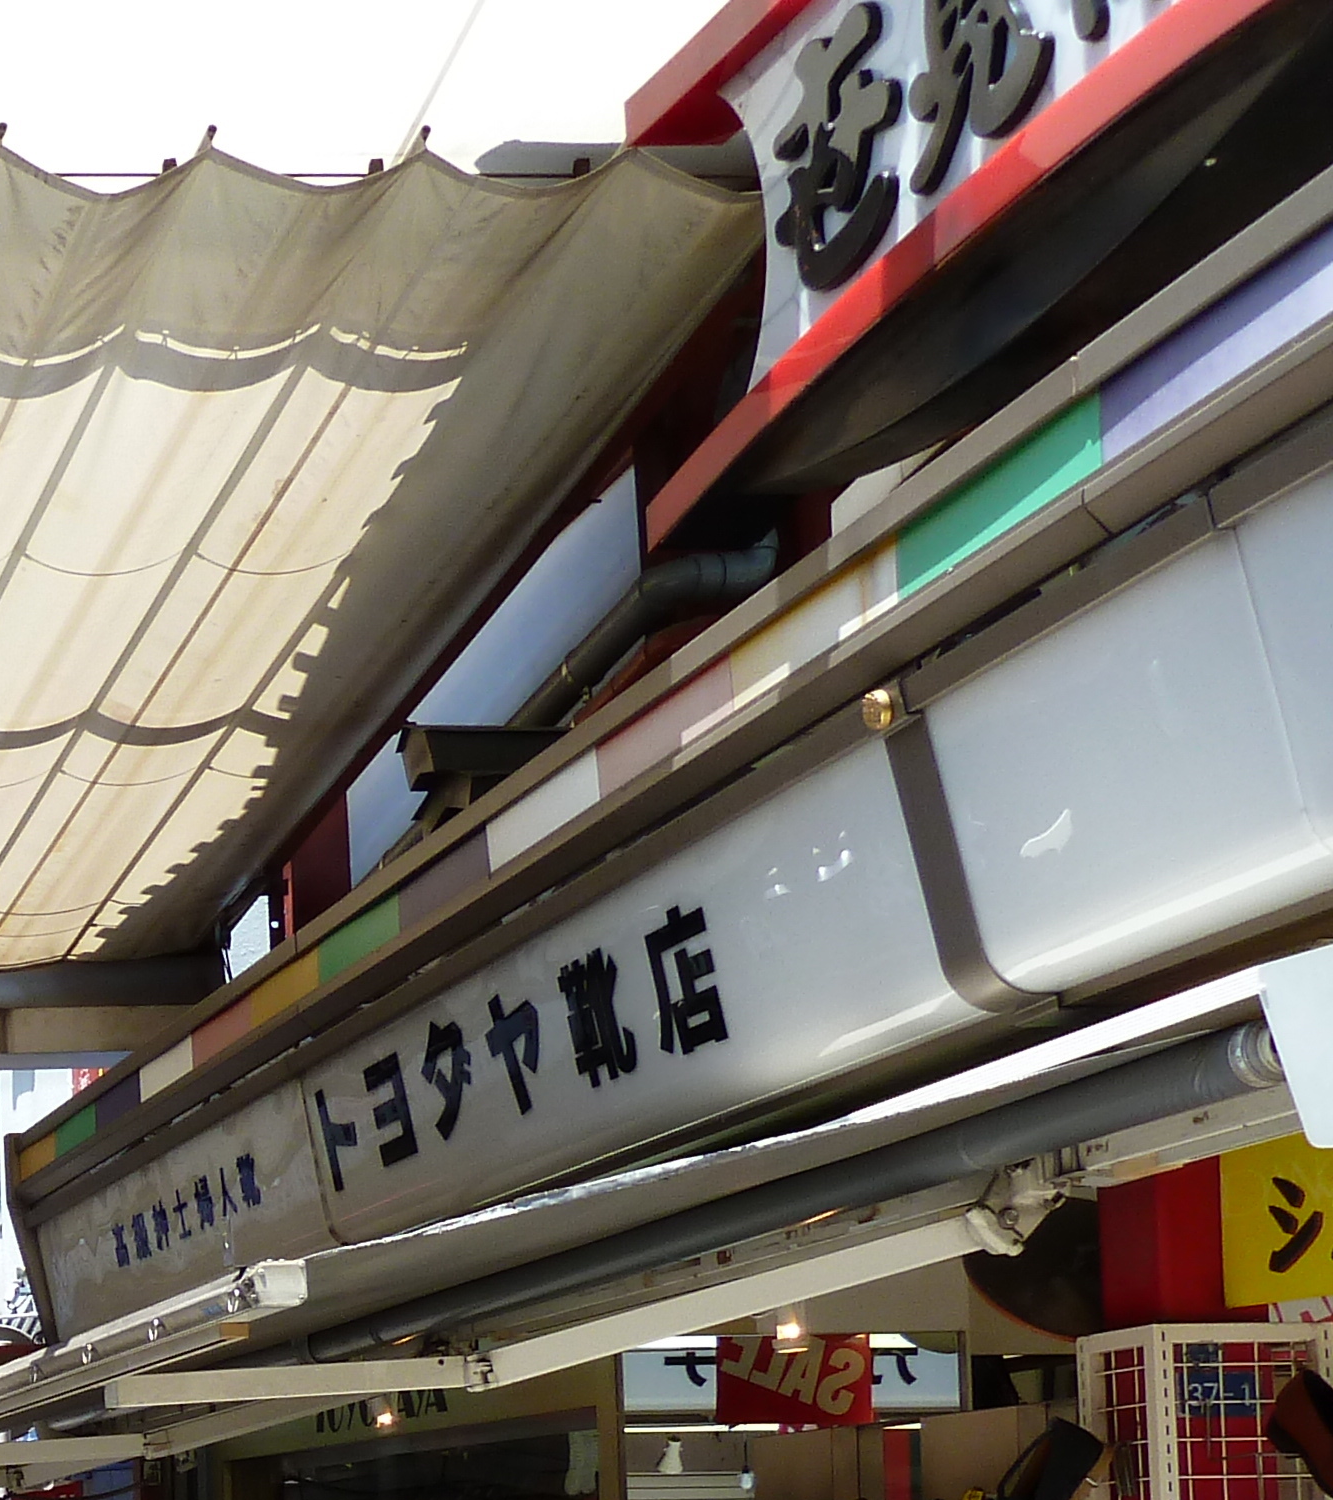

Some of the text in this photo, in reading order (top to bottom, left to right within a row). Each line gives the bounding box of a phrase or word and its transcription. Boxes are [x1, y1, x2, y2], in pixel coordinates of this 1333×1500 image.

[314, 905, 730, 1193] トヨタヤ靴店
